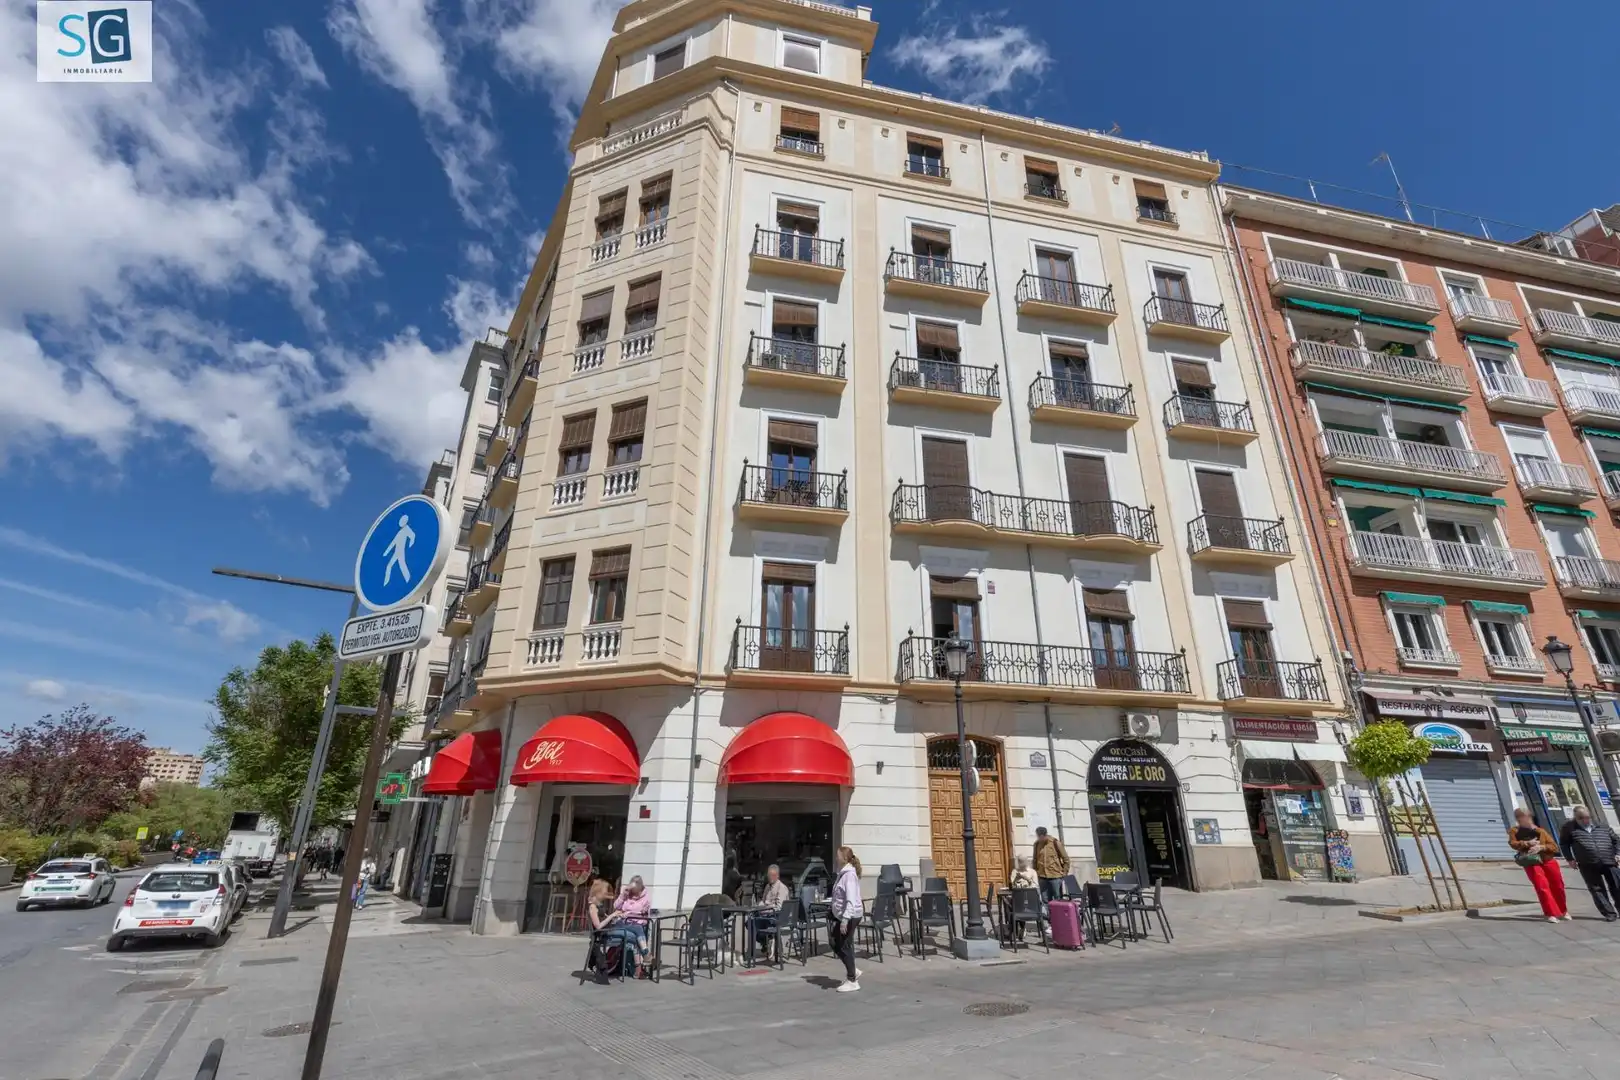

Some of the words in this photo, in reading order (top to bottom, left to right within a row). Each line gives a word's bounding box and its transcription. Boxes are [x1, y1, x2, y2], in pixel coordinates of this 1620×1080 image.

[356, 619, 379, 634] EXPTE.
[382, 613, 410, 630] 3.415/26
[344, 635, 370, 650] PERMITIDO
[382, 625, 418, 643] AUTORIZADOS
[1382, 701, 1442, 712] RESTAURANTE
[1450, 705, 1485, 715] ASADOR
[1236, 720, 1290, 730] ALIMENTACIÓN
[1098, 764, 1127, 773] COMPRA
[1129, 765, 1143, 780] DE
[1144, 766, 1166, 781] ORO
[1100, 772, 1128, 780] VENTA
